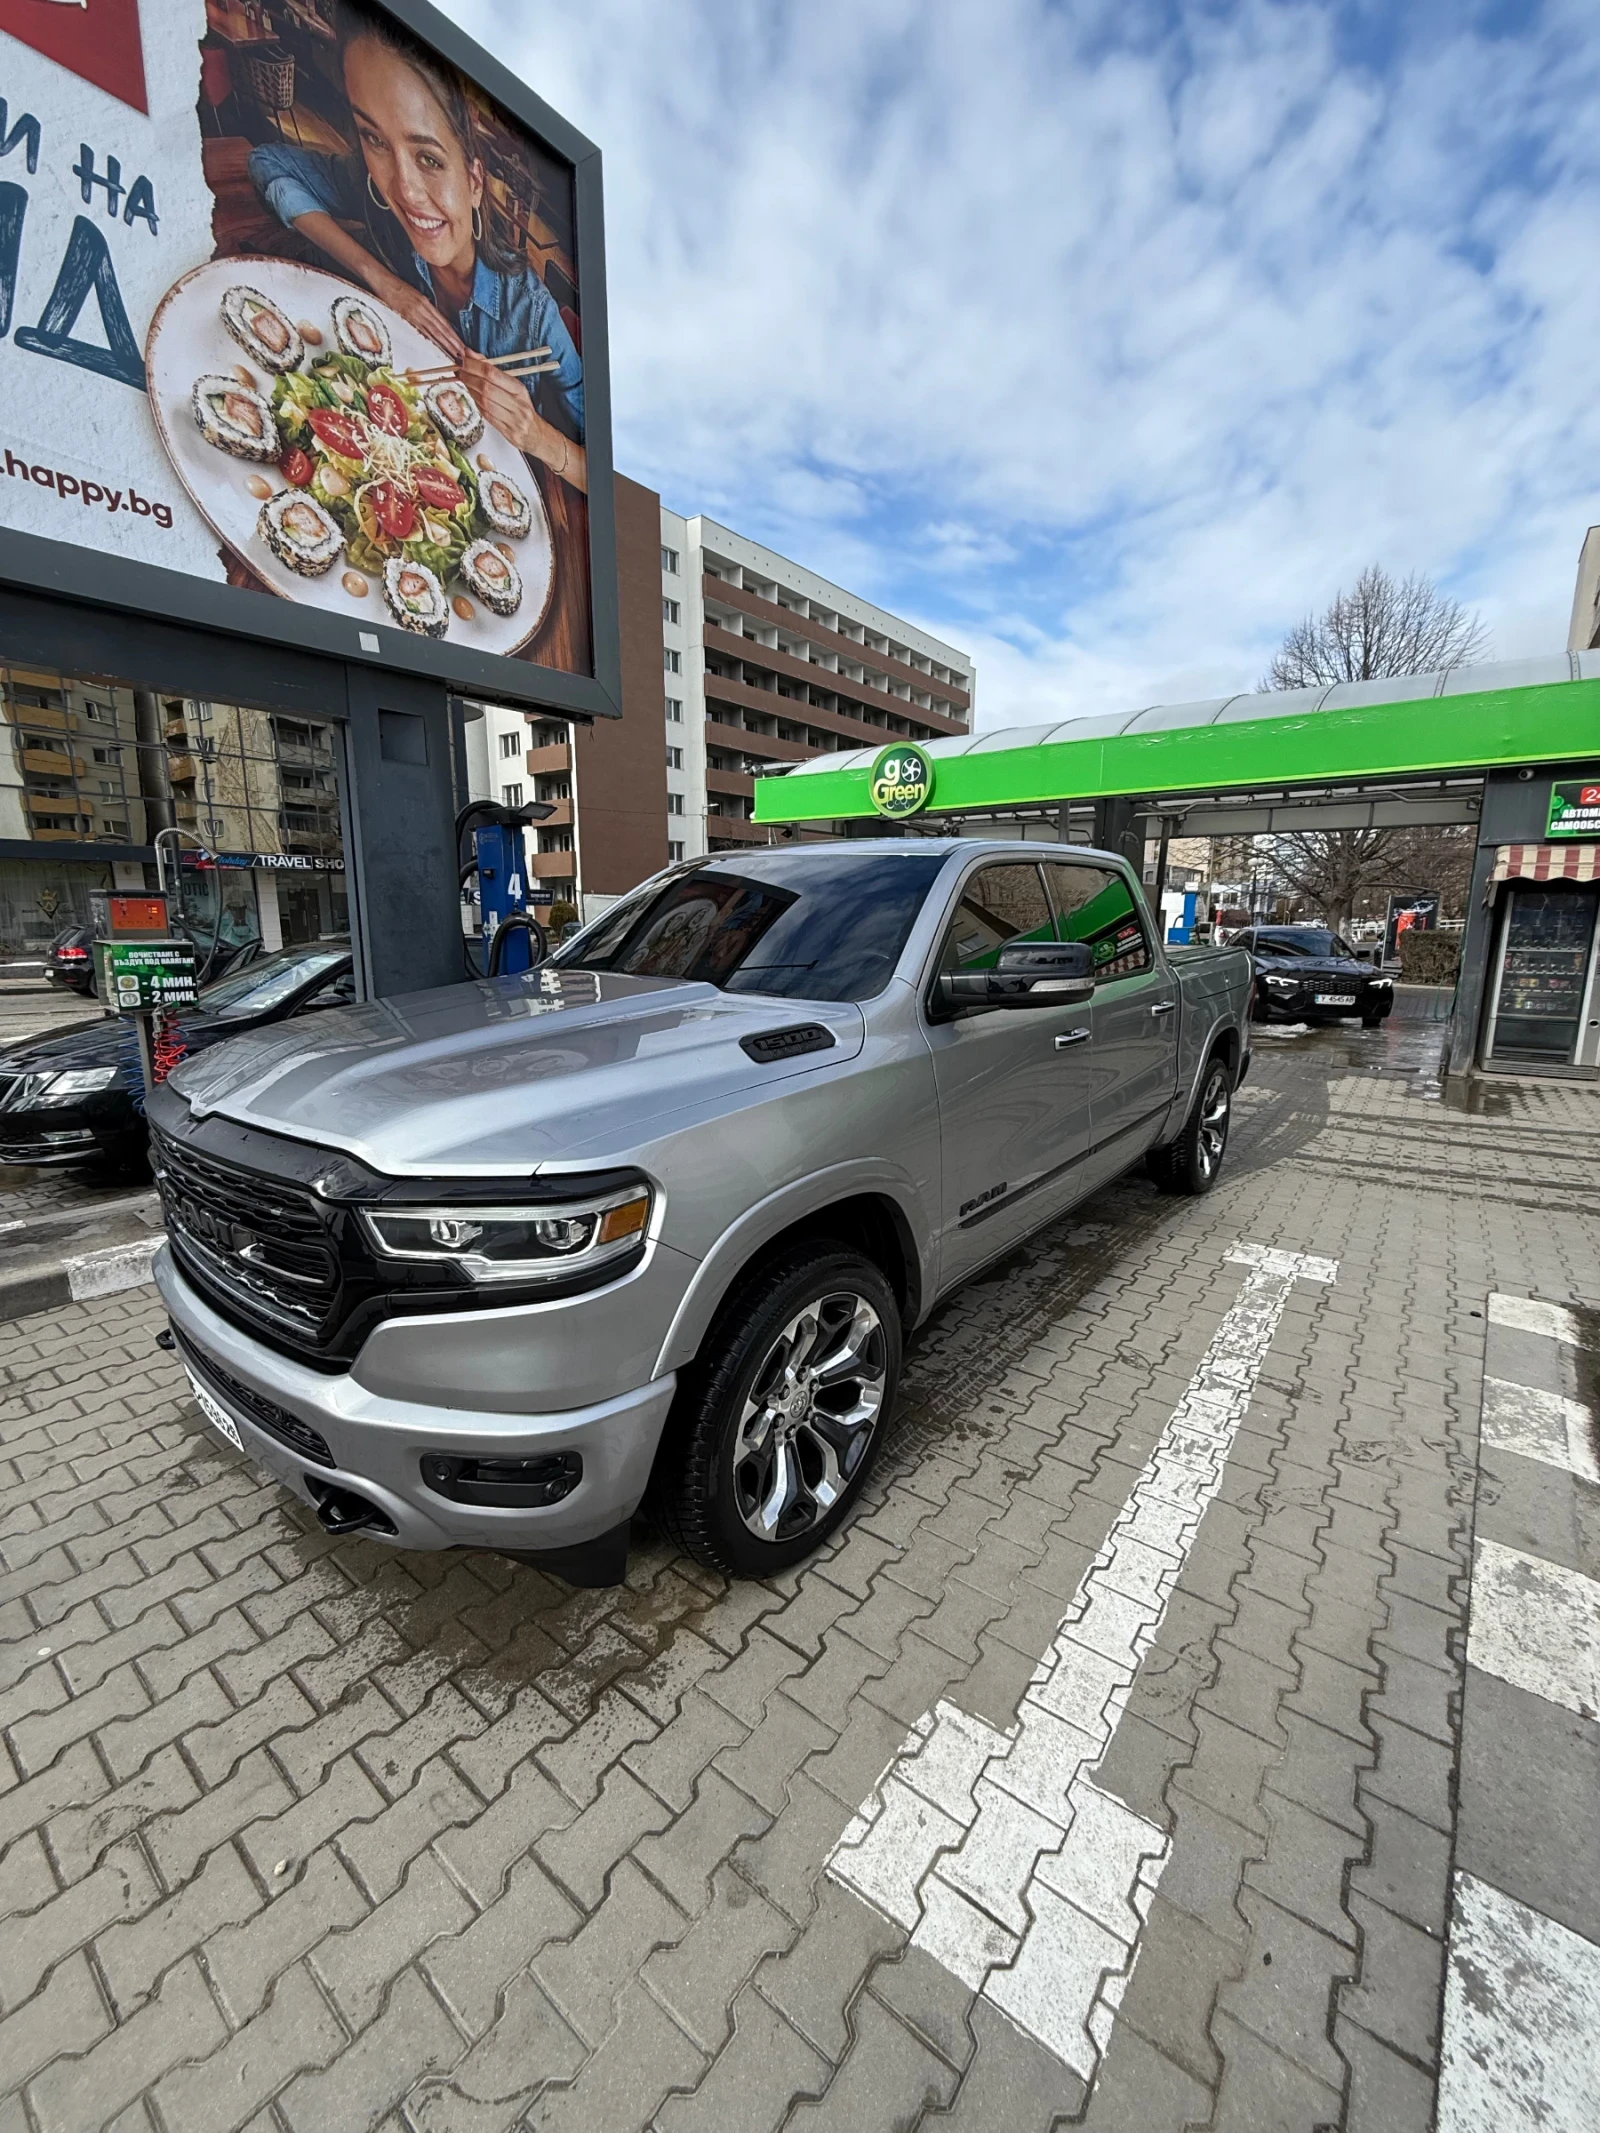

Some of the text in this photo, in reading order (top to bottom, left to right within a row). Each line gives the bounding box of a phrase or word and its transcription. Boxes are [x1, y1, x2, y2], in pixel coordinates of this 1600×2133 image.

[72, 143, 160, 236] НА
[873, 777, 925, 804] Green
[1561, 807, 1600, 819] АВТОМ
[259, 855, 312, 869] TRAVEL
[168, 882, 210, 897] EOTIC
[507, 873, 523, 900] 4
[150, 975, 160, 988] 4
[151, 990, 162, 1003] 2
[753, 1029, 823, 1051] 1500
[959, 1181, 1008, 1218] RAM
